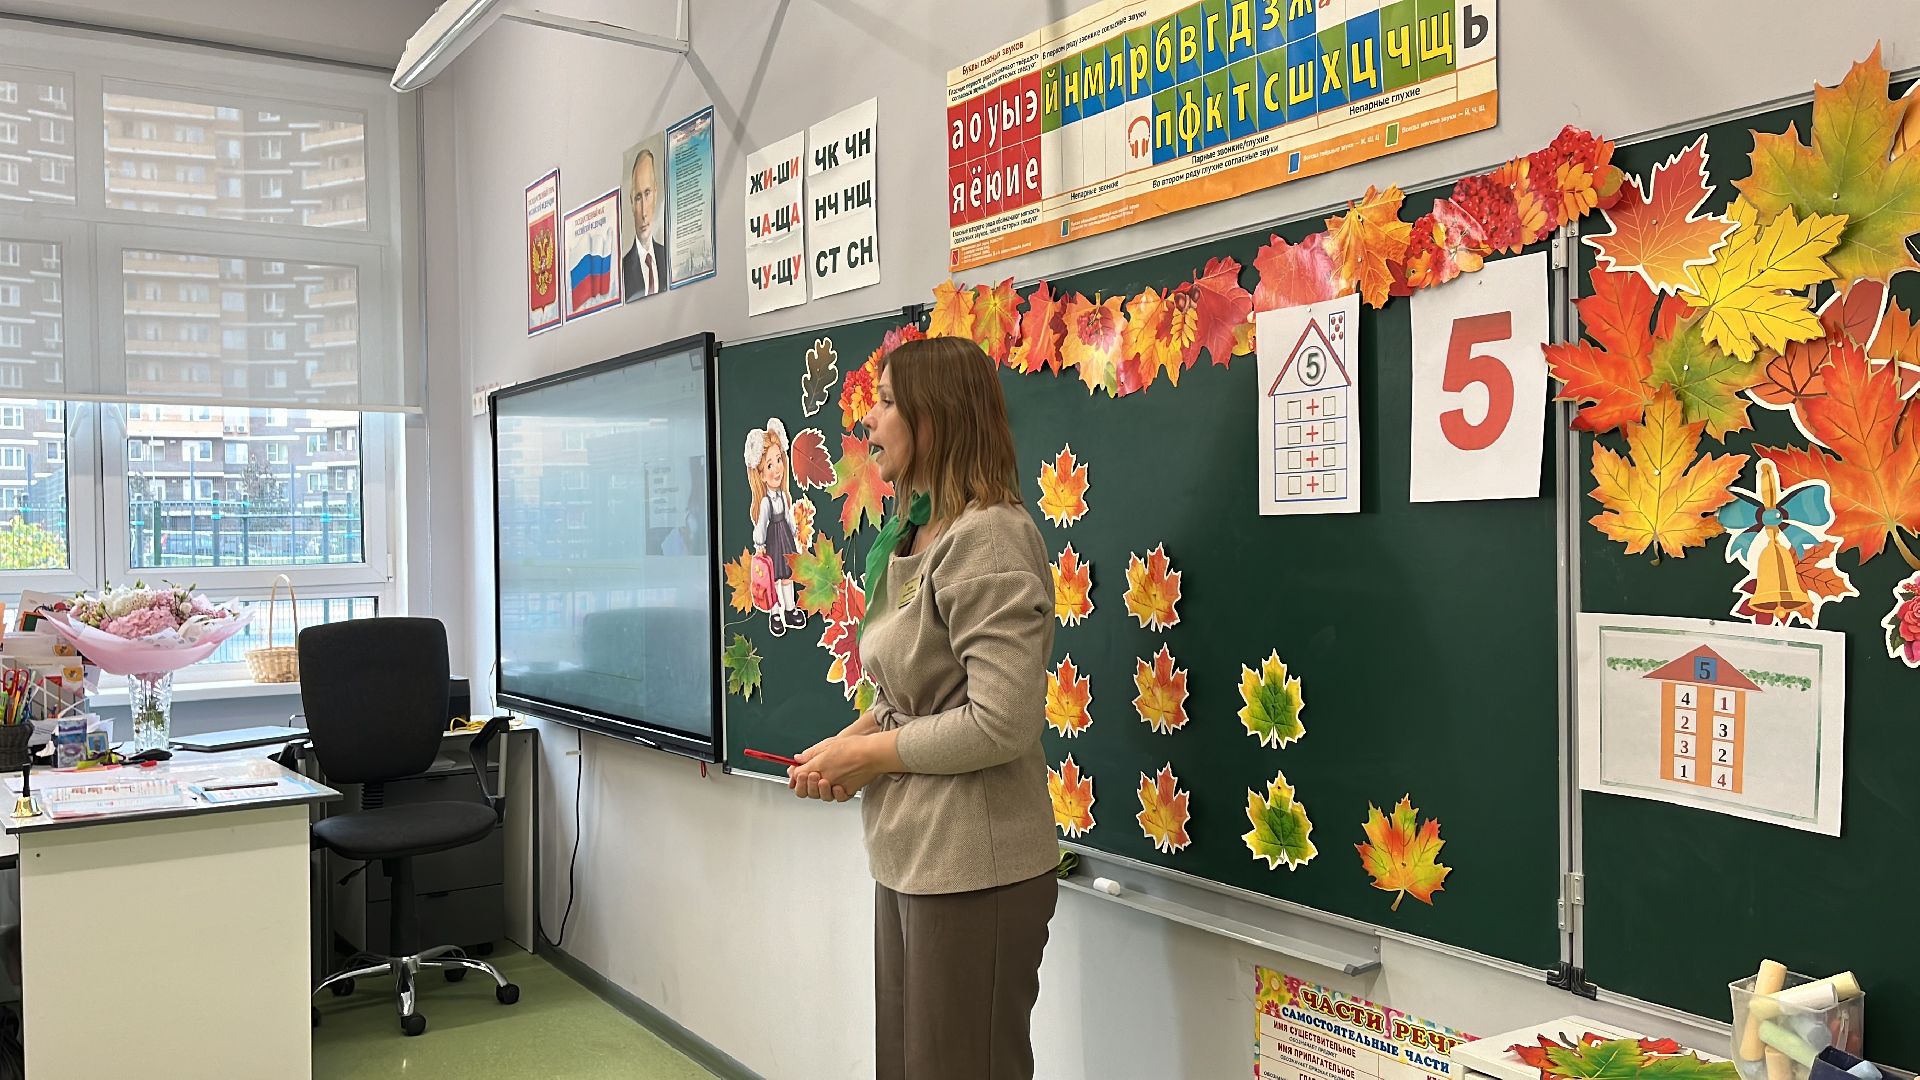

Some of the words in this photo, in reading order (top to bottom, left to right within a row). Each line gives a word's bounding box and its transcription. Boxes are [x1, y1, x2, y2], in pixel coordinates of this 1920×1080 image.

[1002, 41, 1024, 56] звуков
[1349, 98, 1390, 116] Непарные
[1391, 87, 1421, 104] глухие
[815, 141, 839, 171] ЧК
[845, 127, 871, 160] ЧН
[1152, 179, 1161, 189] Во
[1161, 173, 1184, 186] втором
[1185, 169, 1200, 180] ряду
[1201, 163, 1224, 175] глухие
[1224, 151, 1258, 168] согласные
[1259, 144, 1279, 158] звуки
[1192, 152, 1215, 164] Парные
[1216, 134, 1269, 157] звонкие/глухие
[750, 156, 799, 195] ЖИ-ШИ
[1071, 187, 1097, 200] Непарные
[1098, 180, 1119, 193] звонкие
[815, 192, 839, 222] НЧ
[844, 179, 872, 212] НЩ
[750, 202, 800, 238] ЧА-ЩА
[751, 254, 801, 290] ЧУ-ЩУ
[816, 246, 841, 278] СТ
[847, 235, 873, 269] СН
[1305, 352, 1321, 380] 5
[1439, 310, 1514, 451] 5
[1699, 661, 1711, 680] 5
[1681, 692, 1691, 706] 4
[1720, 696, 1728, 711] 1
[1681, 716, 1689, 730] 2
[1719, 723, 1728, 738] 3
[1680, 740, 1689, 754] 3
[1718, 748, 1727, 763] 2
[1681, 764, 1688, 779] 1
[1717, 773, 1727, 787] 4
[1301, 989, 1384, 1031] ЧАСТИ
[1273, 1020, 1288, 1032] ИМЯ
[1289, 1026, 1356, 1058] СУЩЕСТВИТЕЛЬНОЕ
[1281, 1006, 1399, 1057] САМОСТОЯТЕЛЬНЫЕ
[1404, 1049, 1450, 1074] ЧАСТИ
[1277, 1042, 1292, 1055] ИМЯ
[1294, 1048, 1355, 1079] ПРИЛАГАТЕЛЬНОЕ
